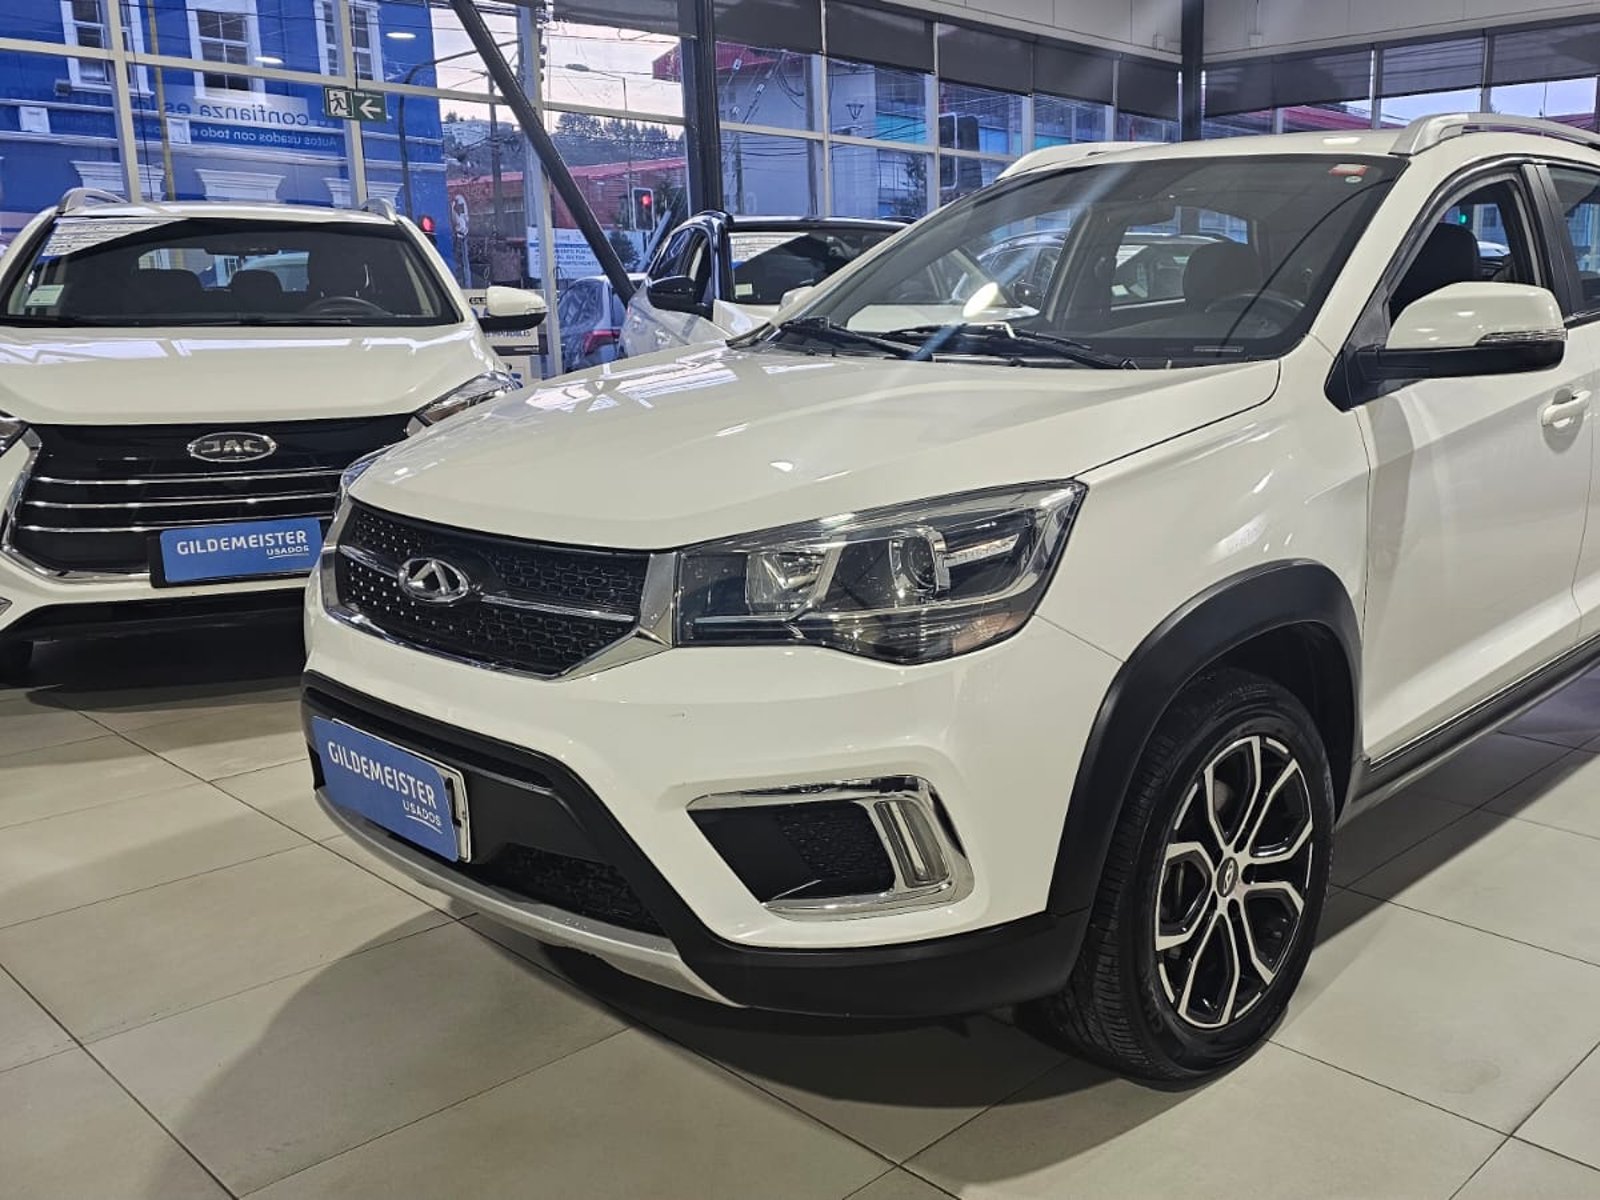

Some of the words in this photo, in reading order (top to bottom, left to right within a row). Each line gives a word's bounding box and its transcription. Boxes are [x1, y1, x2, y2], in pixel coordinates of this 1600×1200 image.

[200, 439, 264, 454] JAC
[176, 530, 308, 555] GILDEMEISTER
[266, 545, 310, 556] USADOS
[328, 741, 437, 809] GILDEMEISTER
[402, 800, 443, 827] USADOS
